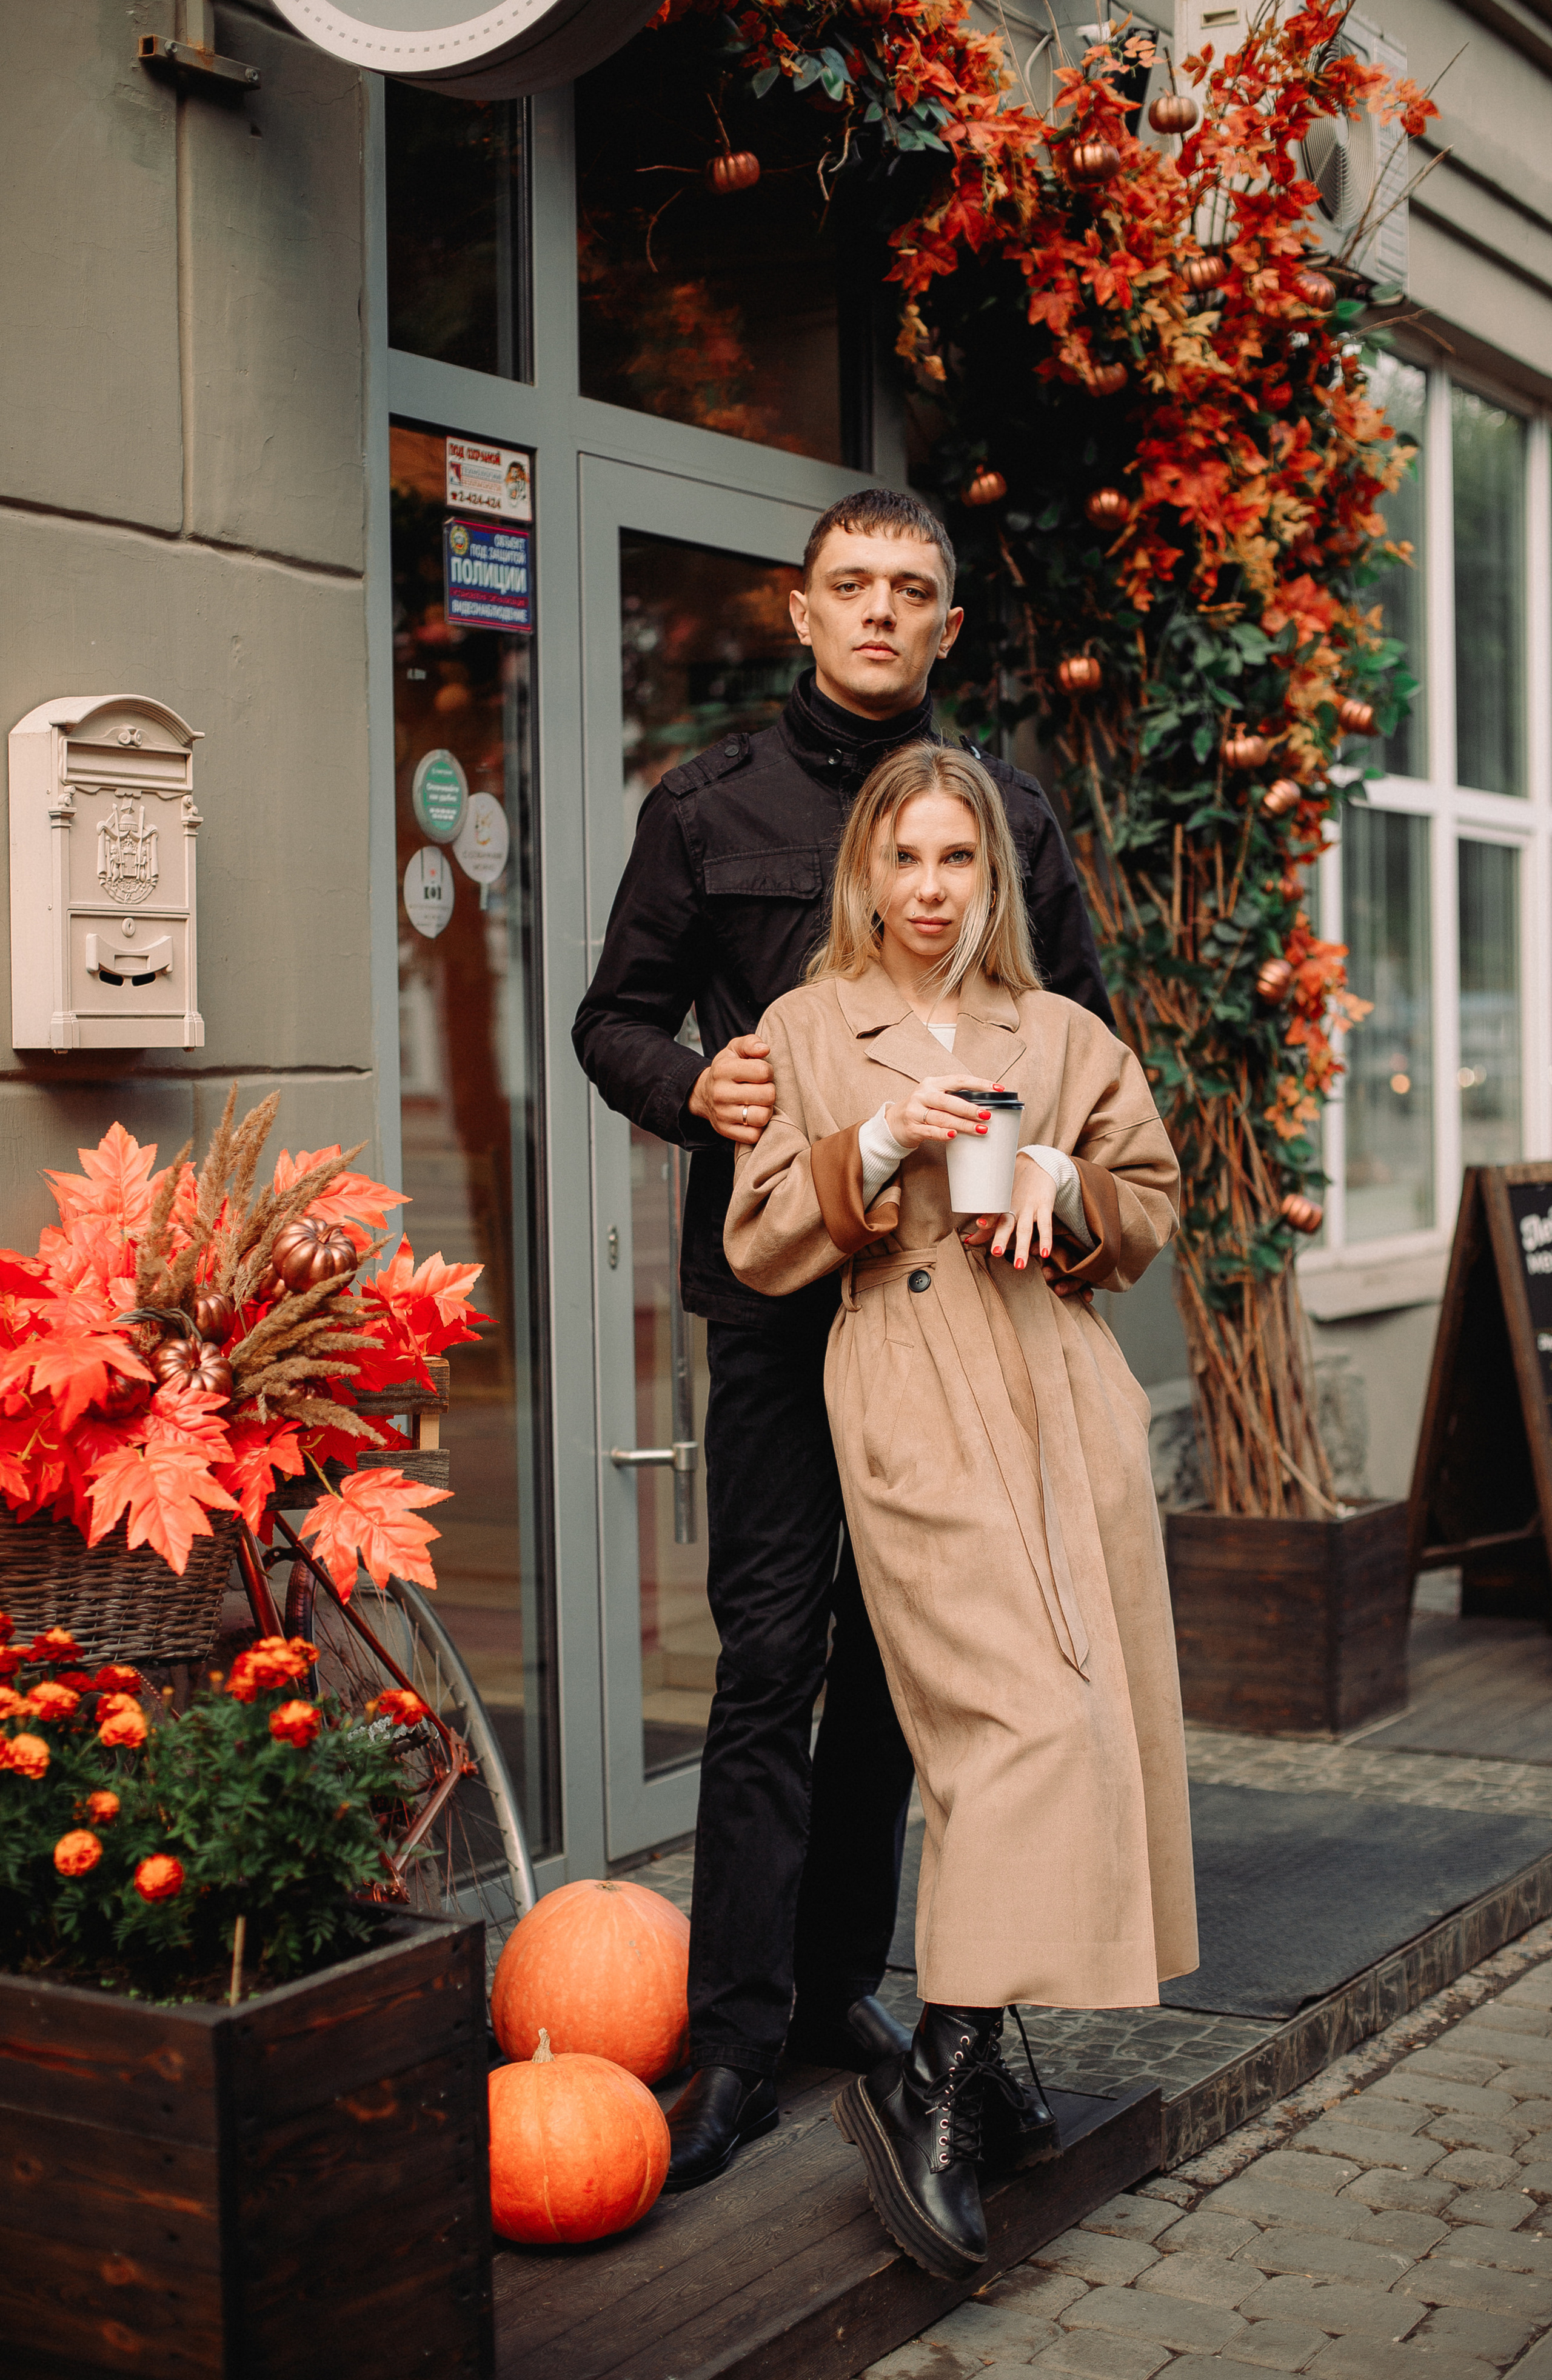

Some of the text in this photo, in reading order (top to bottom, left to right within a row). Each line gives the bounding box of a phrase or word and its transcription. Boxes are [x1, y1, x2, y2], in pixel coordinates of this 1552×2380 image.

[449, 443, 501, 465] ПОД ОХРАНОЙ
[494, 534, 526, 550] ОБЪЕКТ
[470, 543, 527, 565] ПОД ЗАЩИТОЙ
[450, 556, 527, 595] ПОЛИЦИИ
[452, 599, 527, 623] ВИДЕОНАБЛЮДЕНИЕ
